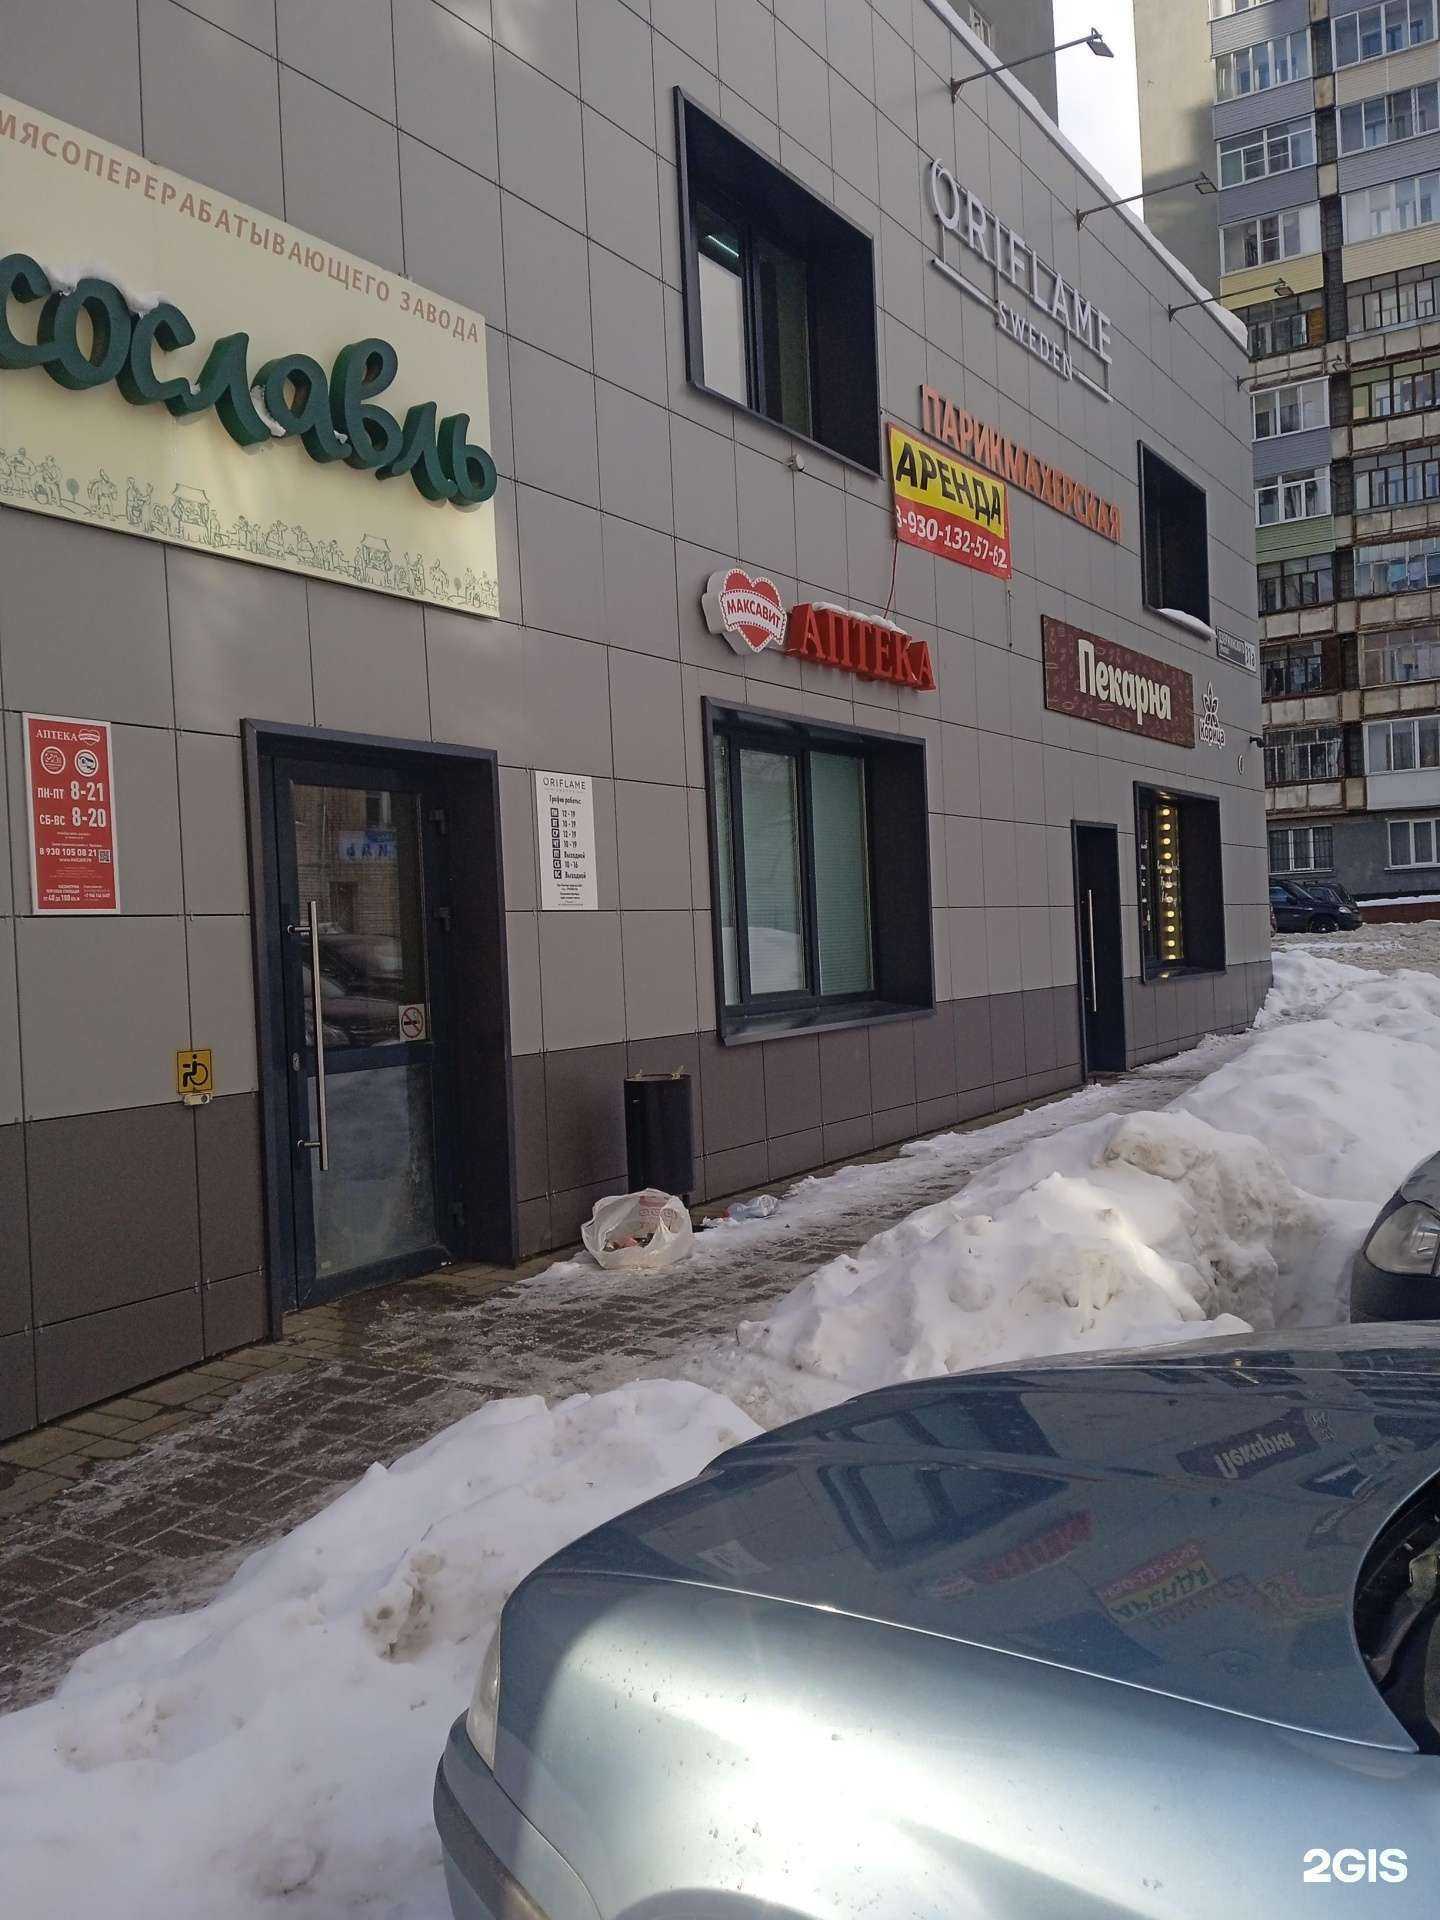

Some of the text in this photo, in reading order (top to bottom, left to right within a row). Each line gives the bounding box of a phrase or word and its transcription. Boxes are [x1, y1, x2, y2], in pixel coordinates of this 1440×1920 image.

[931, 157, 1113, 365] ORIFLAME
[399, 290, 480, 344] ЗАВОДА
[999, 302, 1073, 381] SWEDEN
[895, 442, 1001, 527] АРЕНДА
[920, 384, 1121, 544] ПАРИКМАХЕРСКАЯ
[726, 598, 781, 629] МАКСАВИТ
[794, 603, 936, 692] АПТЕКА
[1077, 638, 1172, 726] Пекарня
[36, 729, 78, 742] АПТЕКА
[37, 780, 105, 802] ПН-ПТ 8-21
[542, 777, 586, 790] ORIFLAME
[39, 806, 107, 828] СБ-ВС 8-20
[45, 847, 60, 856] 930
[88, 849, 97, 857] 21
